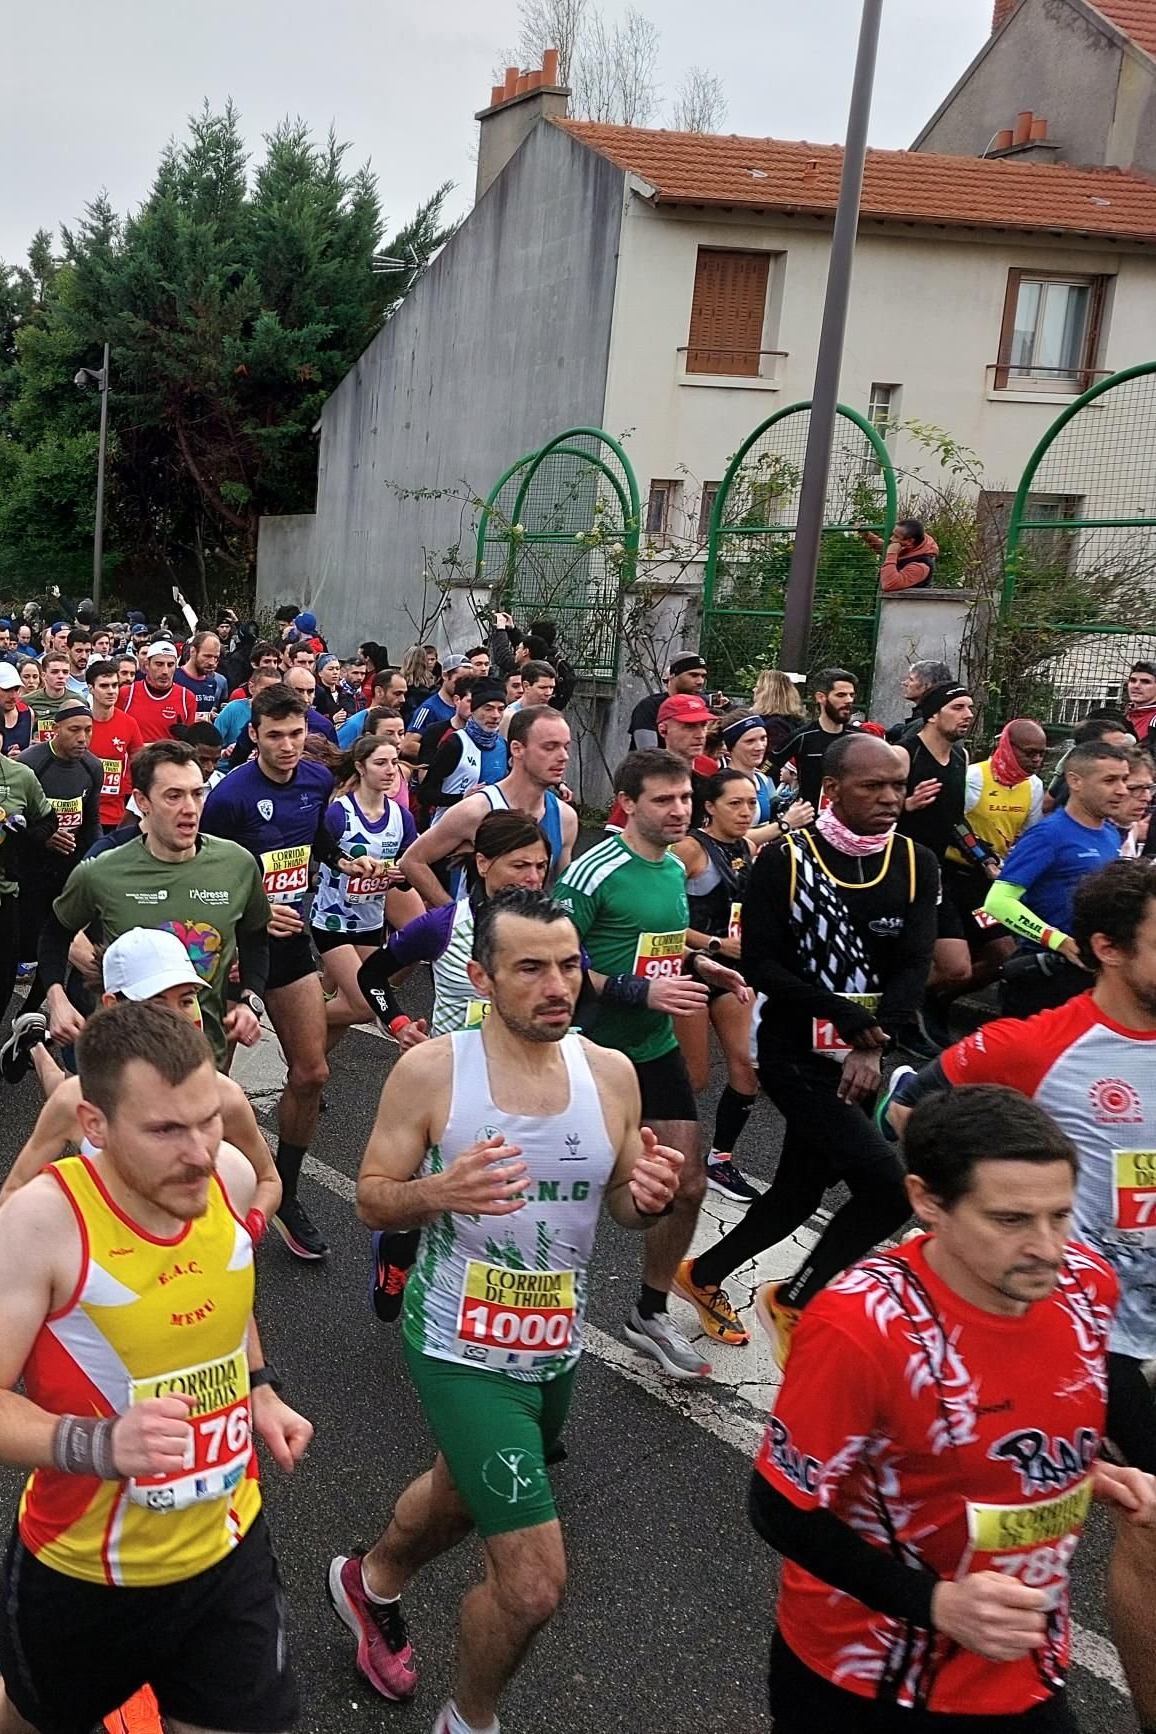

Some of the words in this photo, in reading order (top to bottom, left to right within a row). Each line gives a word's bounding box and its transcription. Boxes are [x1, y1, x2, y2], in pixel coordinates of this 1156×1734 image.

[272, 848, 304, 862] CORRIDA
[273, 862, 281, 871] DE
[266, 868, 306, 891] 1843
[350, 877, 389, 892] 1695
[189, 889, 229, 899] l'Adresse
[644, 958, 682, 980] 993
[486, 1268, 562, 1292] CORRIDA
[485, 1286, 505, 1304] DE
[513, 1291, 561, 1307] THIAIS
[466, 1305, 570, 1345] 1000
[155, 1360, 238, 1398] CORRIDA
